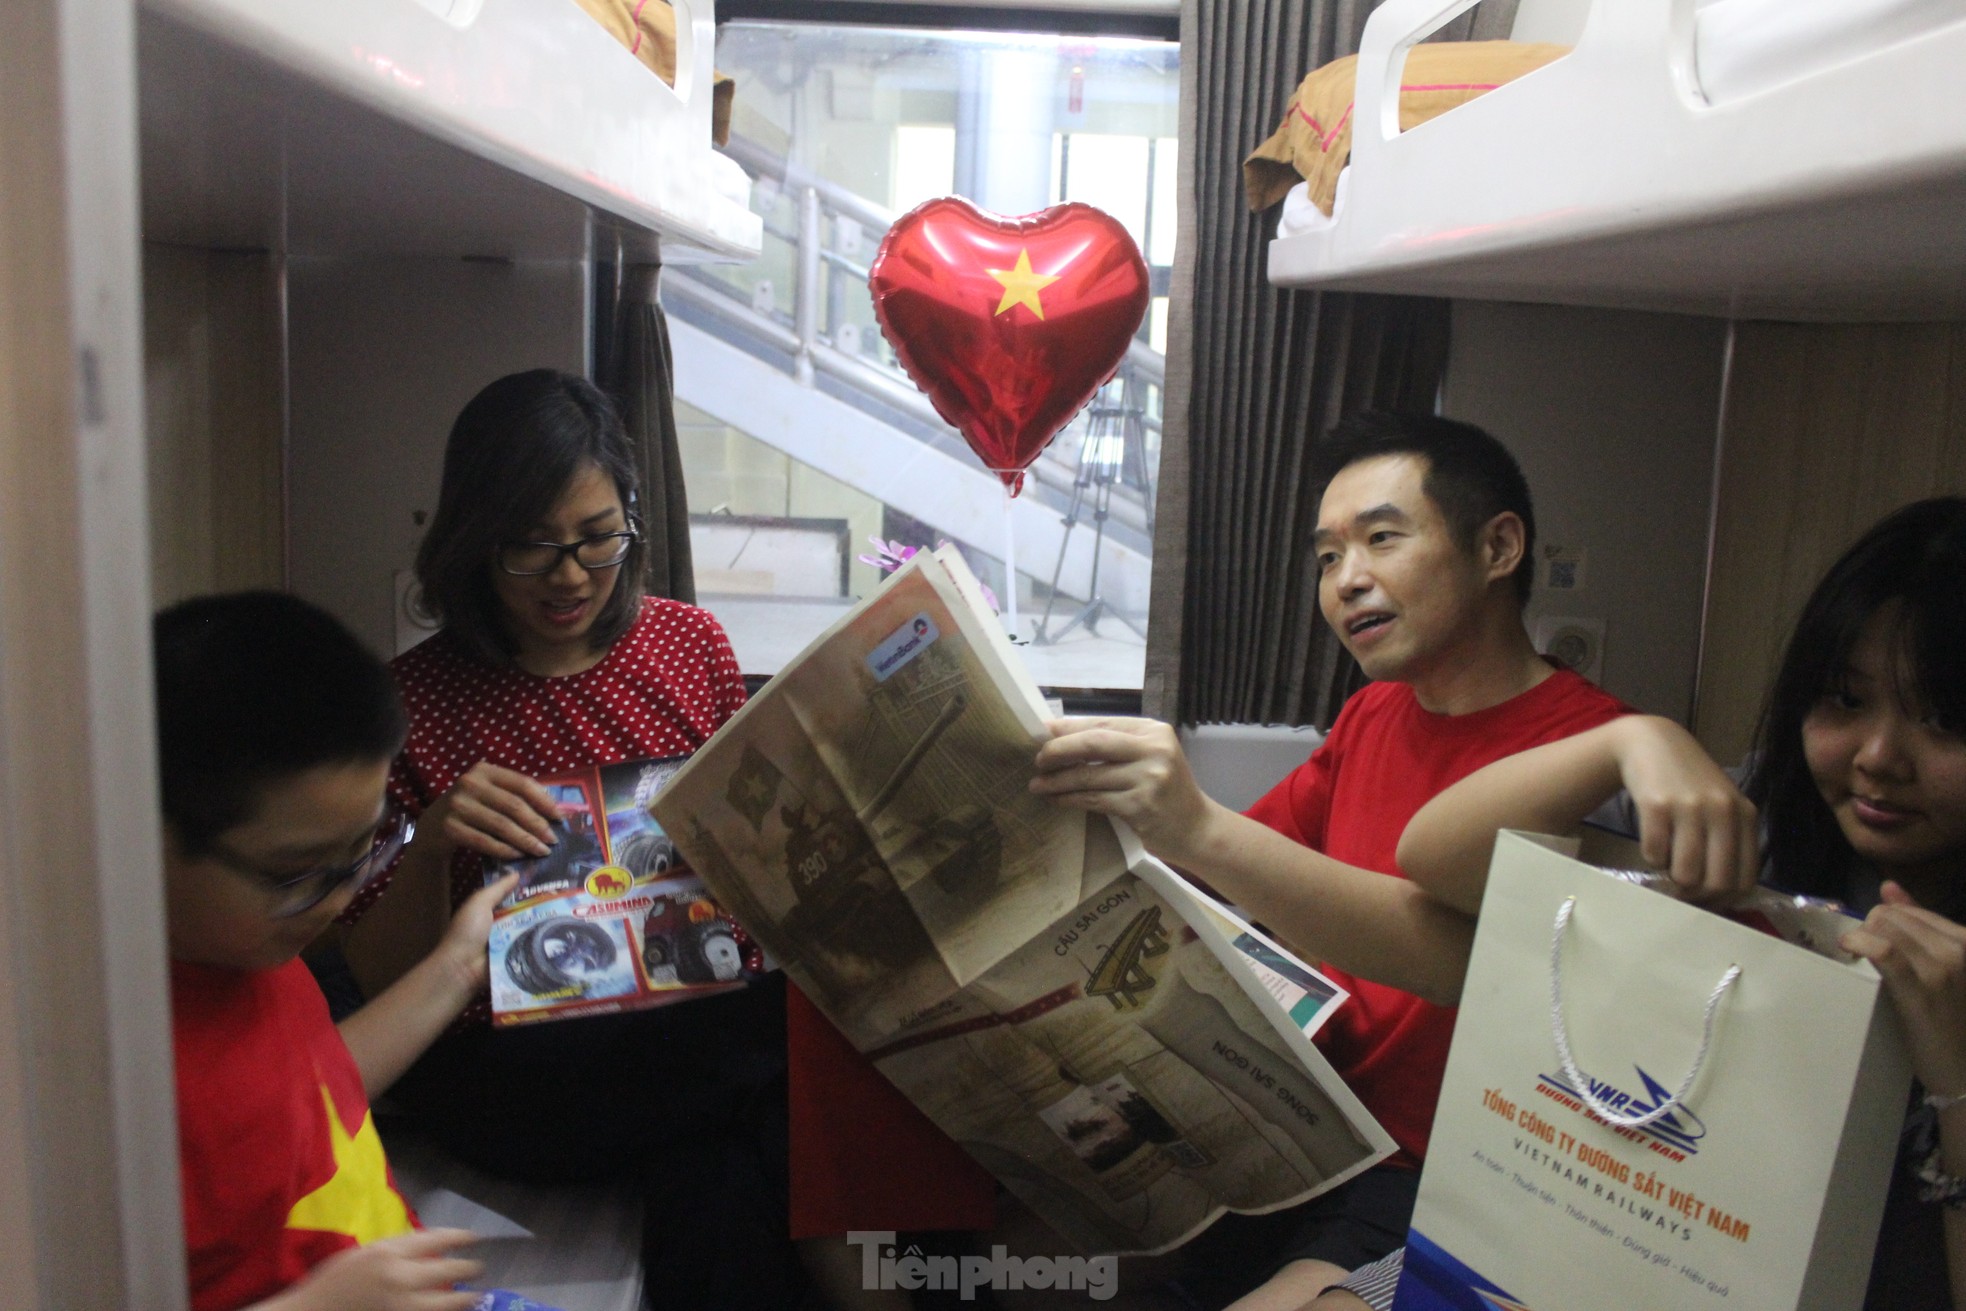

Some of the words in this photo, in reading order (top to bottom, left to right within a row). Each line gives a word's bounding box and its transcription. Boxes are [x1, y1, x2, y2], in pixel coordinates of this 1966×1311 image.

[798, 850, 827, 885] 390
[1589, 1077, 1630, 1109] VNR
[1648, 1141, 1687, 1163] NAM
[1514, 1137, 1588, 1189] VIETNAM
[1594, 1184, 1691, 1241] RAILWAYS
[1519, 1109, 1555, 1144] CÔNG
[1558, 1131, 1576, 1154] TY
[1633, 1171, 1665, 1200] SẮT
[1669, 1187, 1705, 1220] VIỆT
[1706, 1207, 1750, 1242] NAM
